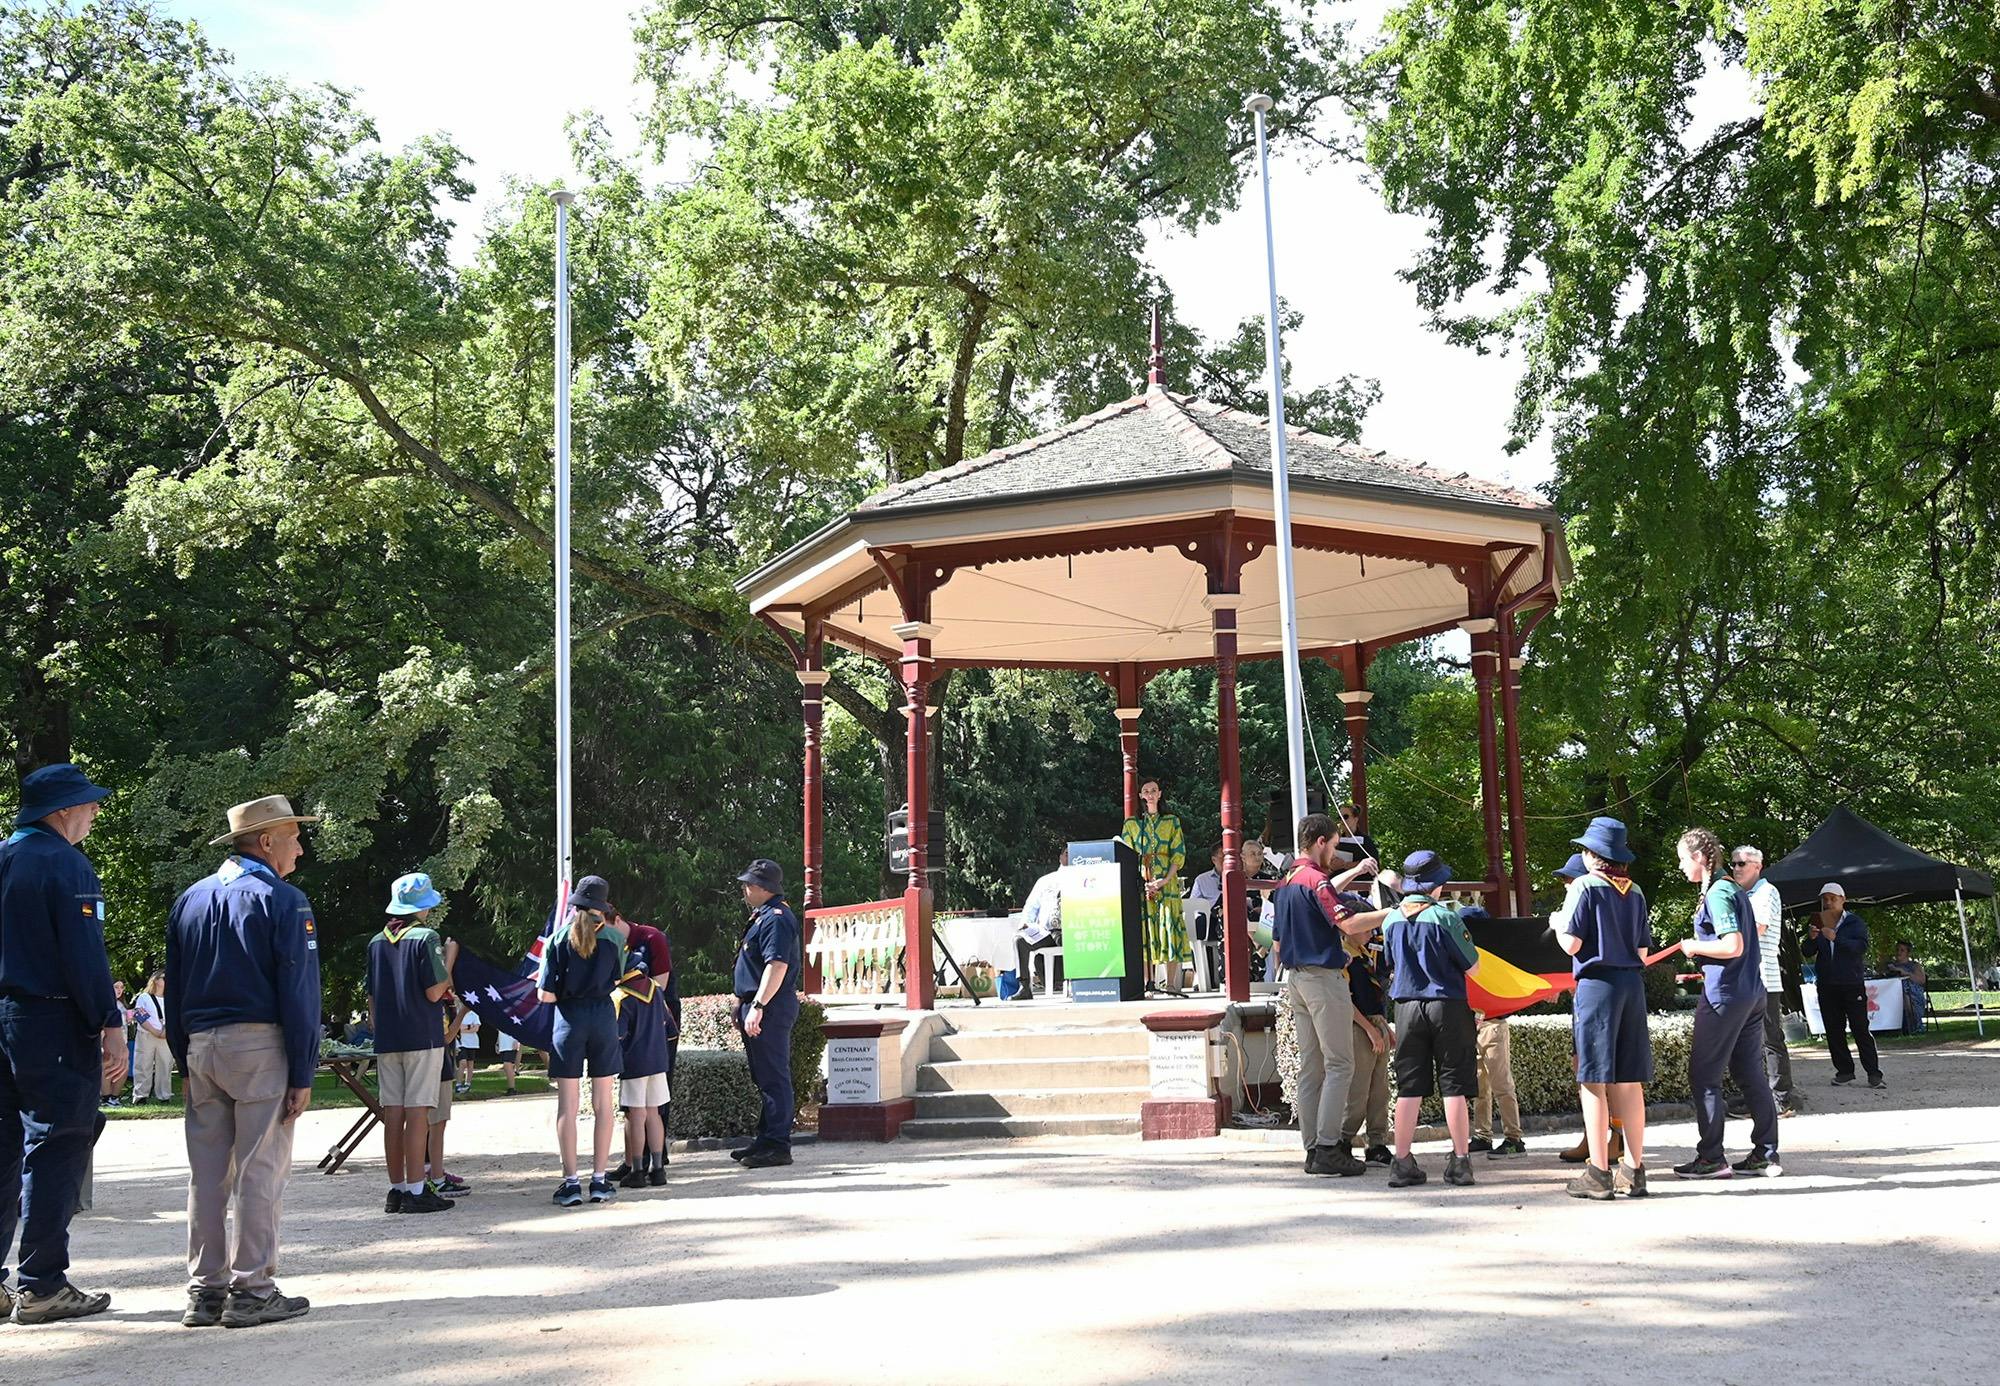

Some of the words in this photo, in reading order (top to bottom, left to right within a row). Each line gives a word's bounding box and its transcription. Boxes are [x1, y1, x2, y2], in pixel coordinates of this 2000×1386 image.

[1068, 918, 1088, 928] ALL
[1088, 917, 1117, 928] PART
[1073, 930, 1089, 941] OF
[1091, 929, 1111, 940] THE
